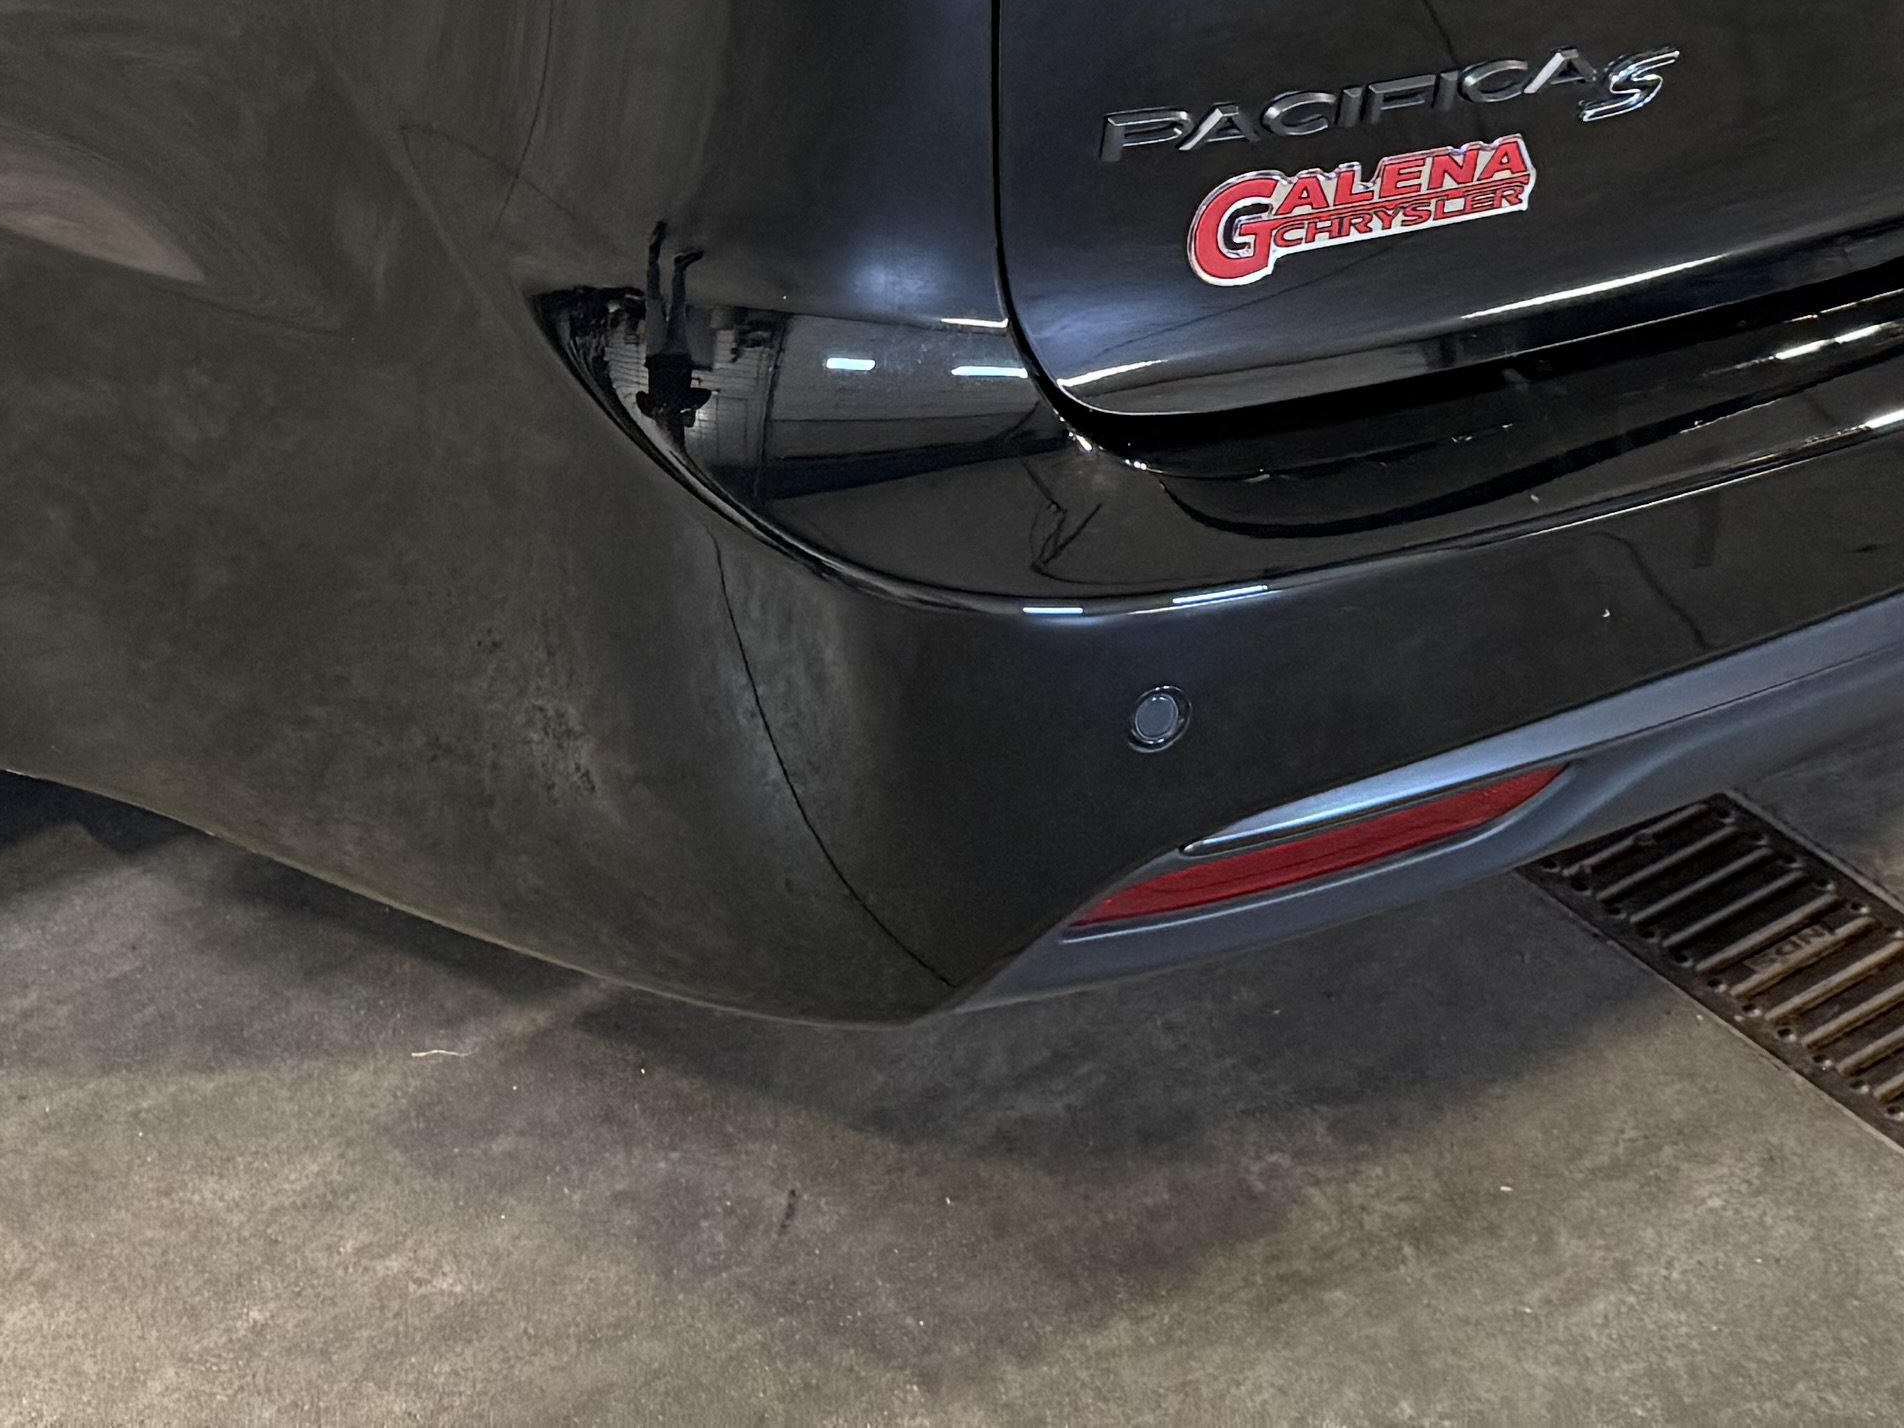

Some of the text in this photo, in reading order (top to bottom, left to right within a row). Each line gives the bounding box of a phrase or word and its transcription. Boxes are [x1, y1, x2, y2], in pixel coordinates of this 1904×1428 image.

[1100, 46, 1680, 162] PACIFICA S
[1190, 138, 1530, 281] GALENA
[1273, 185, 1523, 248] CHRYSLER
